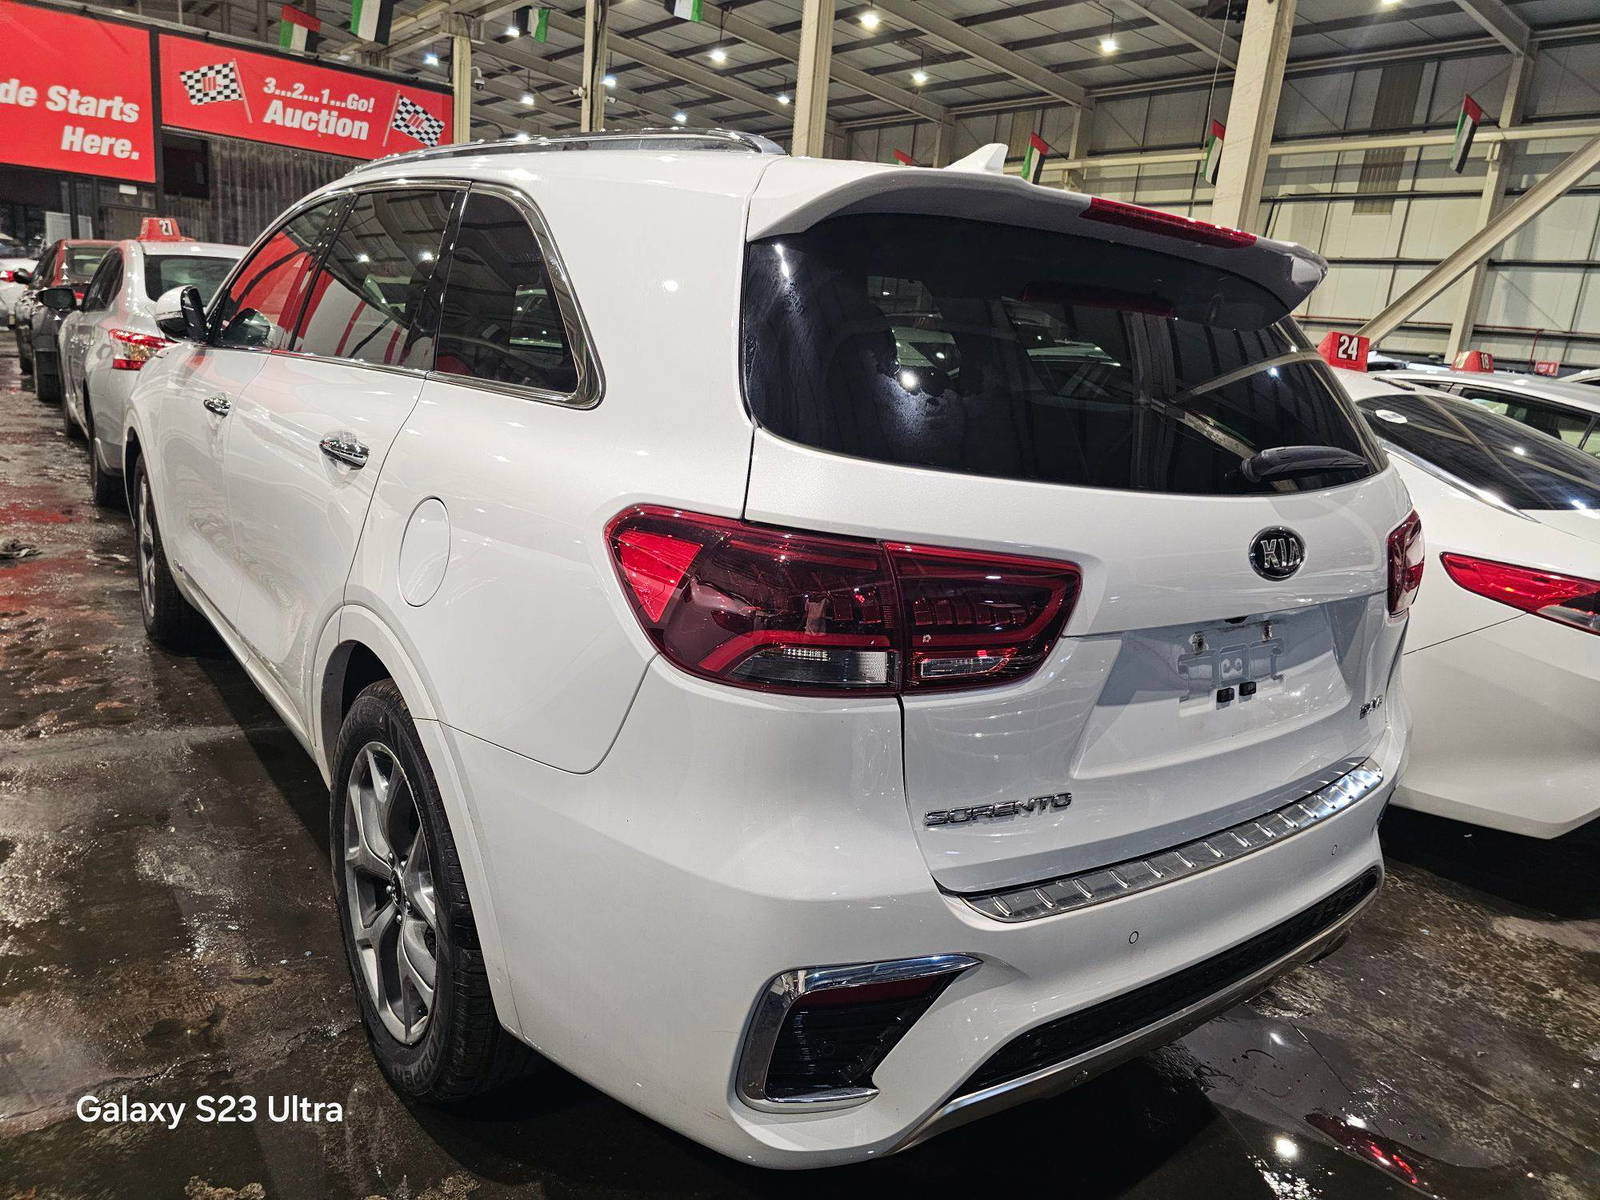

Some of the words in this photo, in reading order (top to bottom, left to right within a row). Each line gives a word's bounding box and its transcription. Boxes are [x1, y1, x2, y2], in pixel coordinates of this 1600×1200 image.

[46, 85, 140, 123] Starts
[263, 99, 369, 140] Auction
[61, 125, 140, 161] Here.
[1338, 335, 1359, 361] 24
[1261, 537, 1301, 568] KIA
[924, 792, 1073, 826] SORENTO
